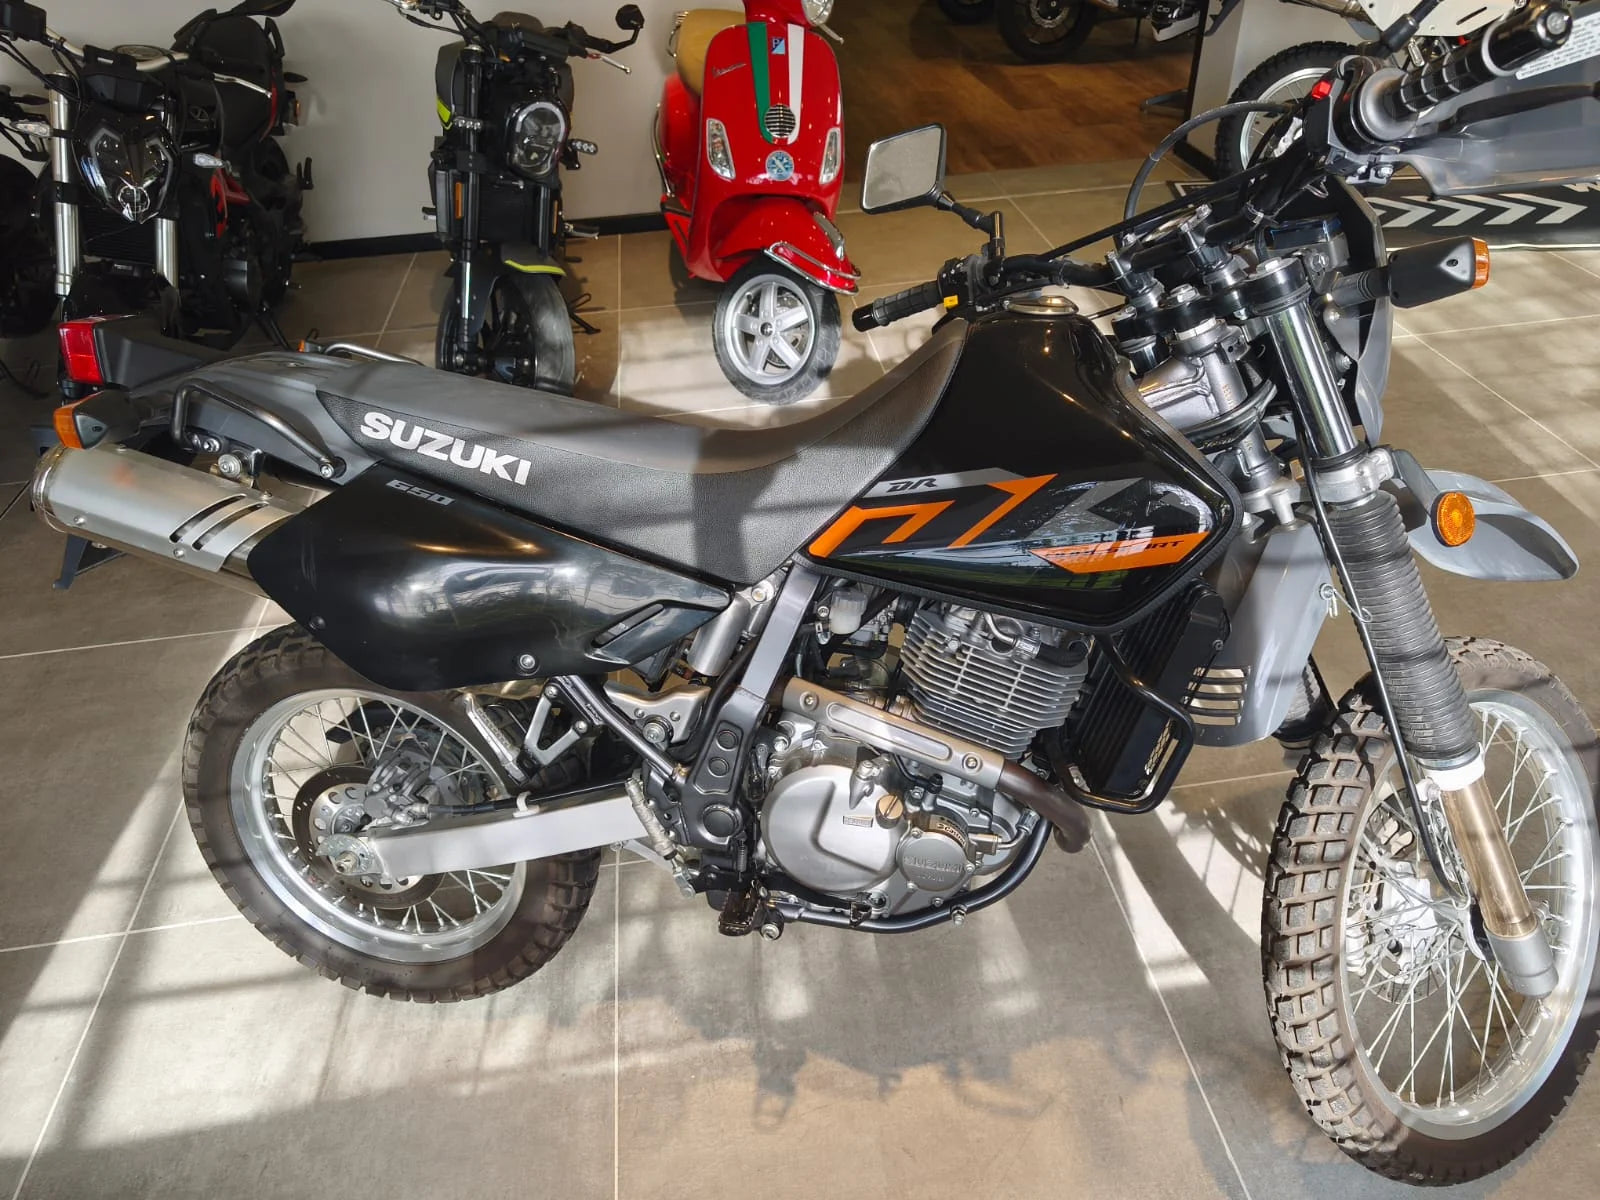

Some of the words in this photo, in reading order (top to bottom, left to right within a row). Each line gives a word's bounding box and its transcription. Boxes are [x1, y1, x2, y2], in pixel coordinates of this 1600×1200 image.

[360, 411, 532, 486] SUZUKI
[386, 479, 455, 506] 650
[886, 478, 938, 493] DR
